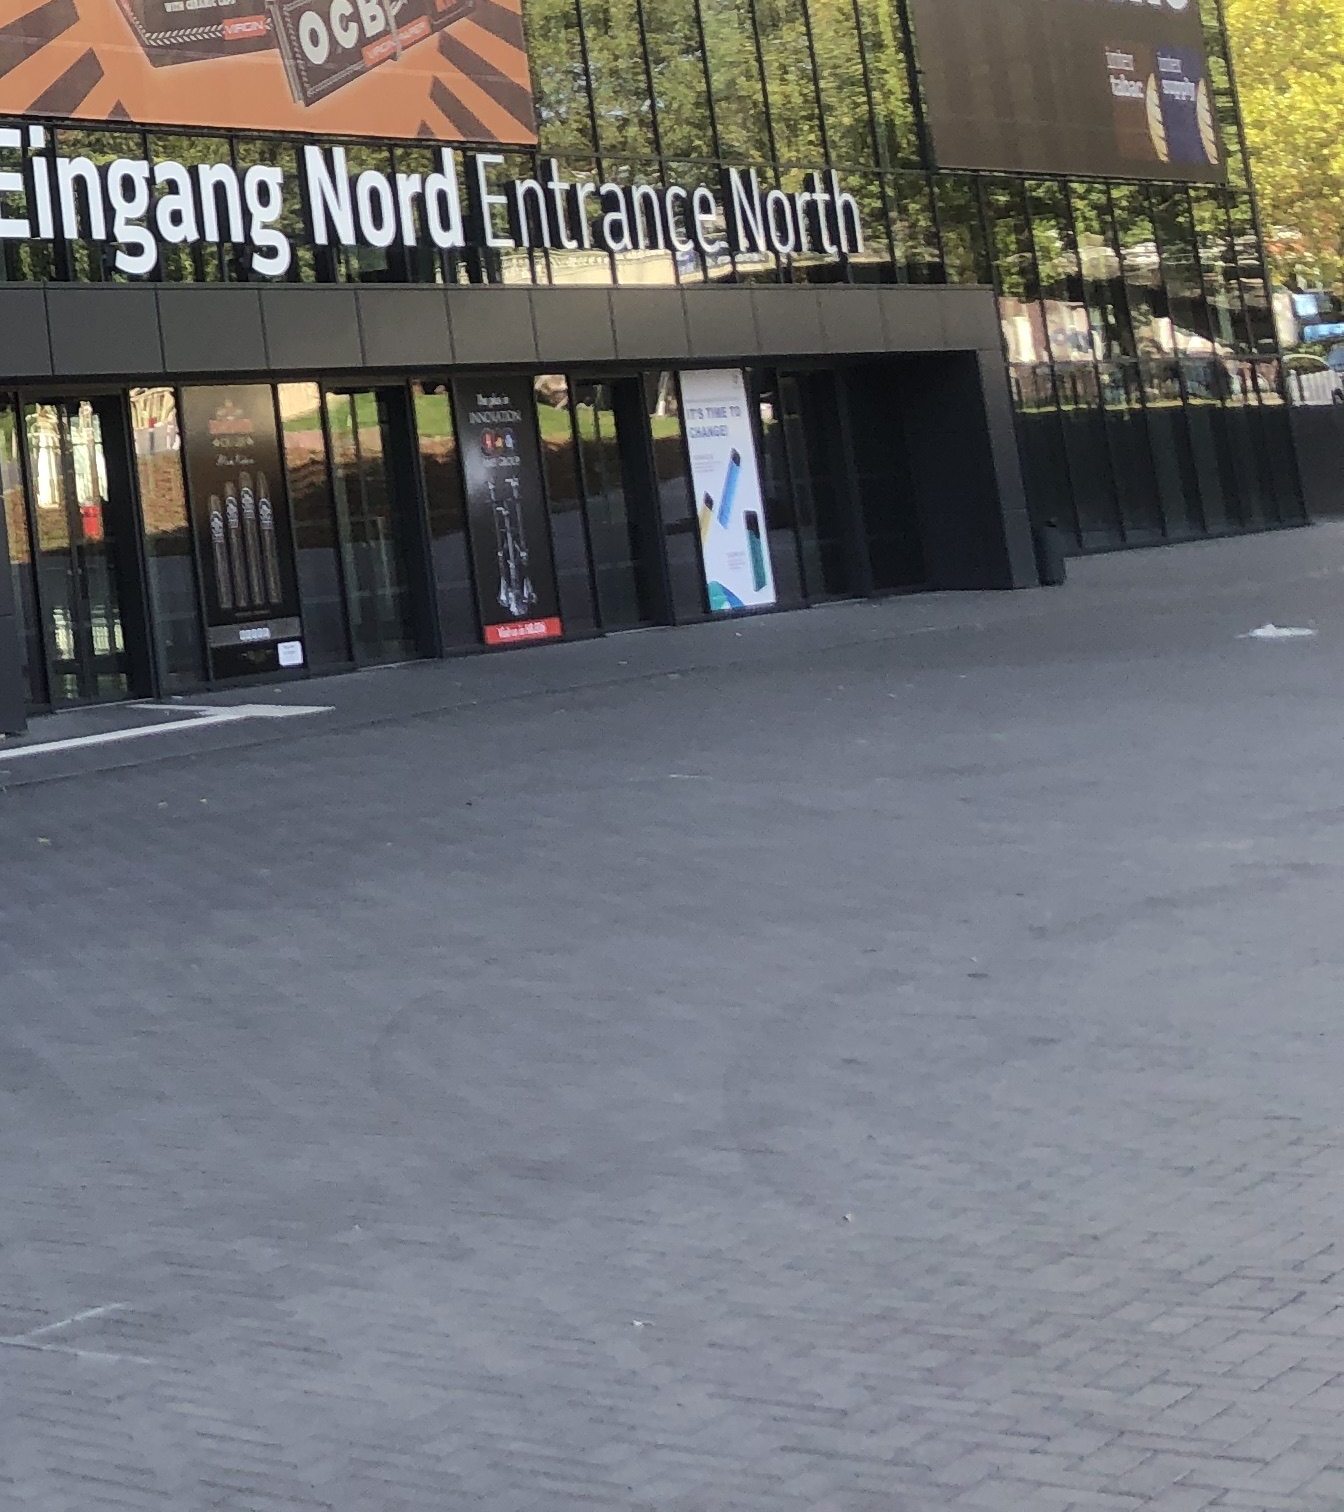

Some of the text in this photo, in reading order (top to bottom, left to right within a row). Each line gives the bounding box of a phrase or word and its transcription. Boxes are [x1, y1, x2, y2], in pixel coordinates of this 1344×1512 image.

[303, 144, 466, 249] Nord
[476, 153, 729, 254] Entrance
[728, 167, 866, 255] North
